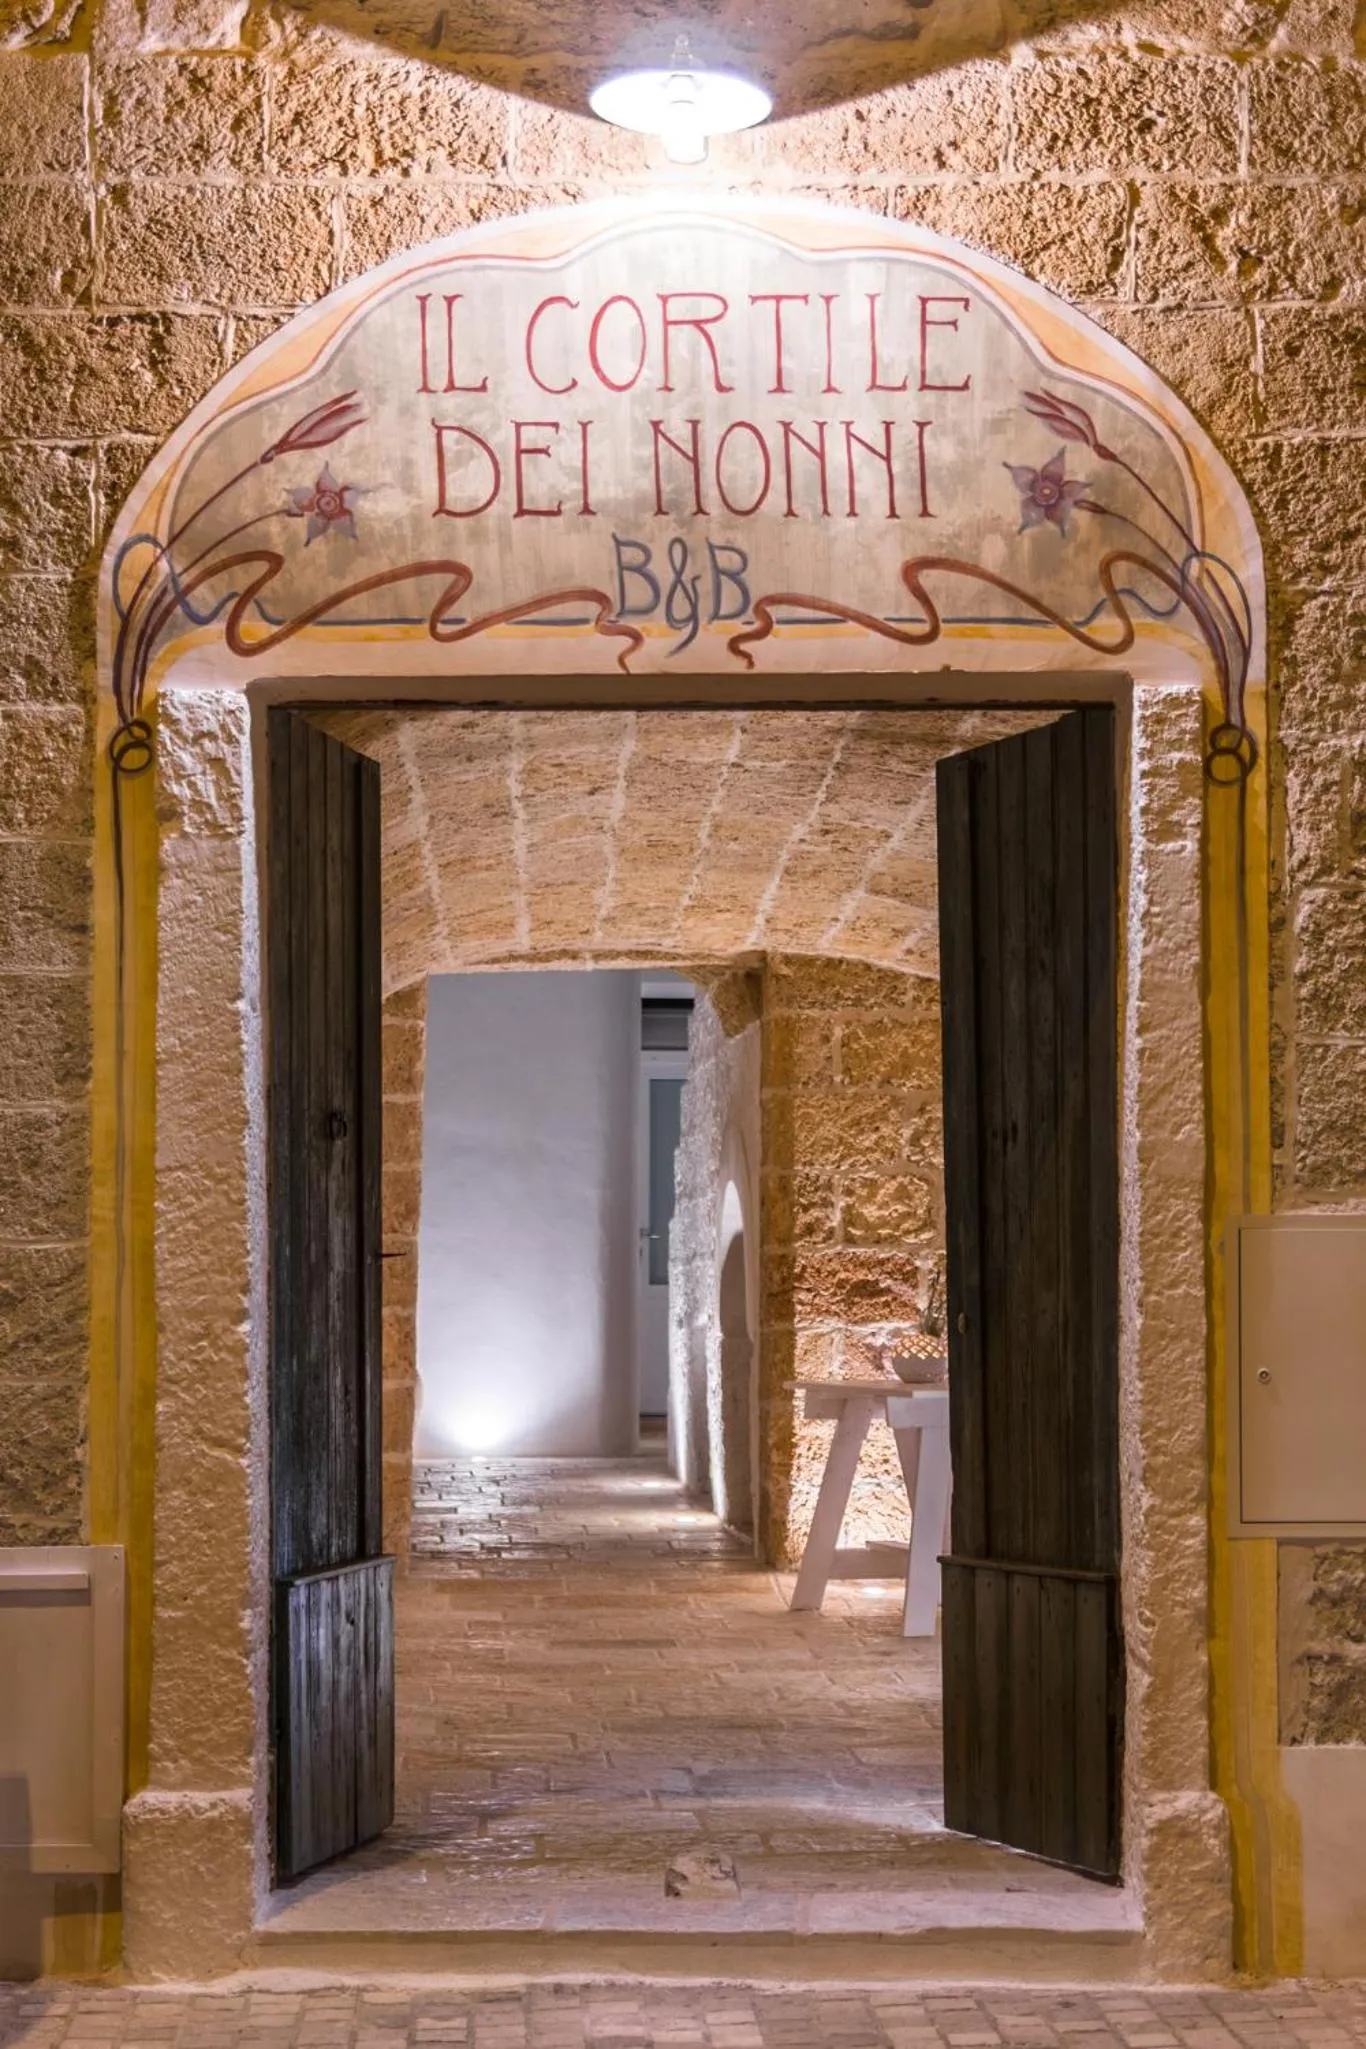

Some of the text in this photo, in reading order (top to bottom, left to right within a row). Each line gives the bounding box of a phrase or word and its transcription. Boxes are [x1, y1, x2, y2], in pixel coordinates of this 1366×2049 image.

[416, 292, 971, 394] IL CORTILE
[431, 417, 937, 519] DEI NONNI
[611, 532, 751, 657] B&B
